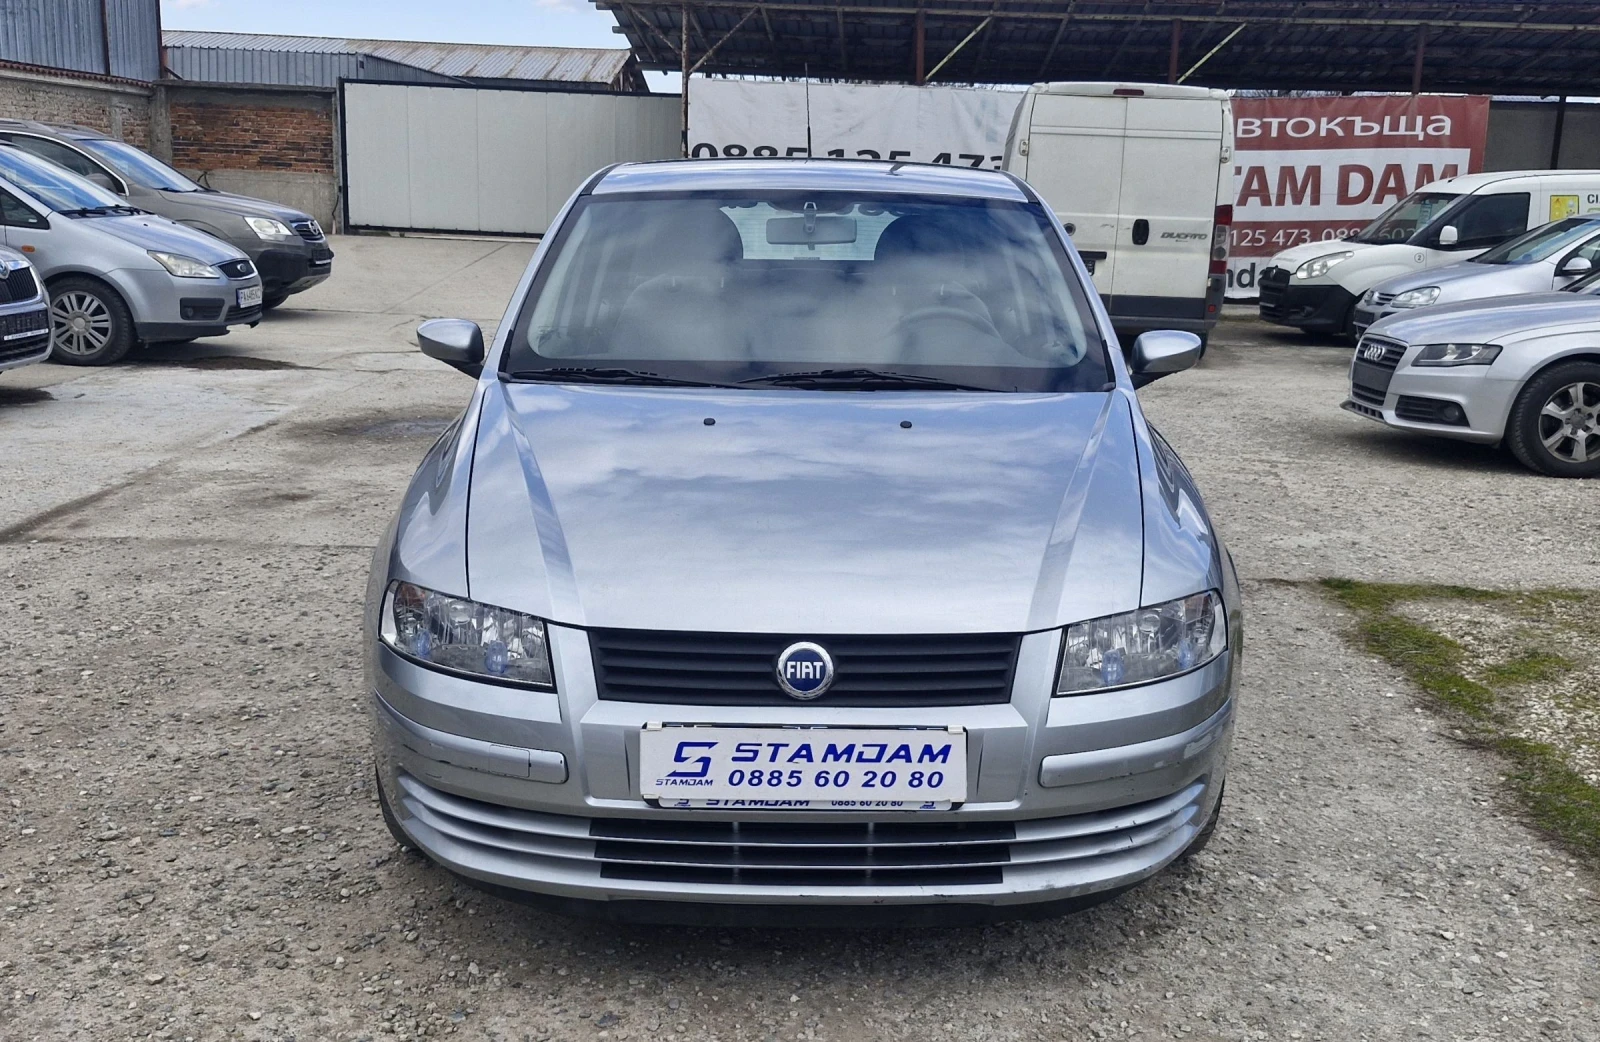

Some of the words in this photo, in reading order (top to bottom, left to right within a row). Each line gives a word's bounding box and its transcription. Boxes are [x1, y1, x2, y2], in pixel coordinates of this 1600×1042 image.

[1234, 165, 1321, 207] AM
[1230, 229, 1266, 247] 125
[1271, 229, 1311, 246] 473
[786, 661, 824, 679] FIAT
[731, 743, 952, 764] STAMDAM
[656, 778, 714, 786] STAMDAM
[728, 769, 802, 787] 0885
[814, 770, 850, 788] 60
[861, 770, 897, 788] 20
[908, 771, 944, 788] 80
